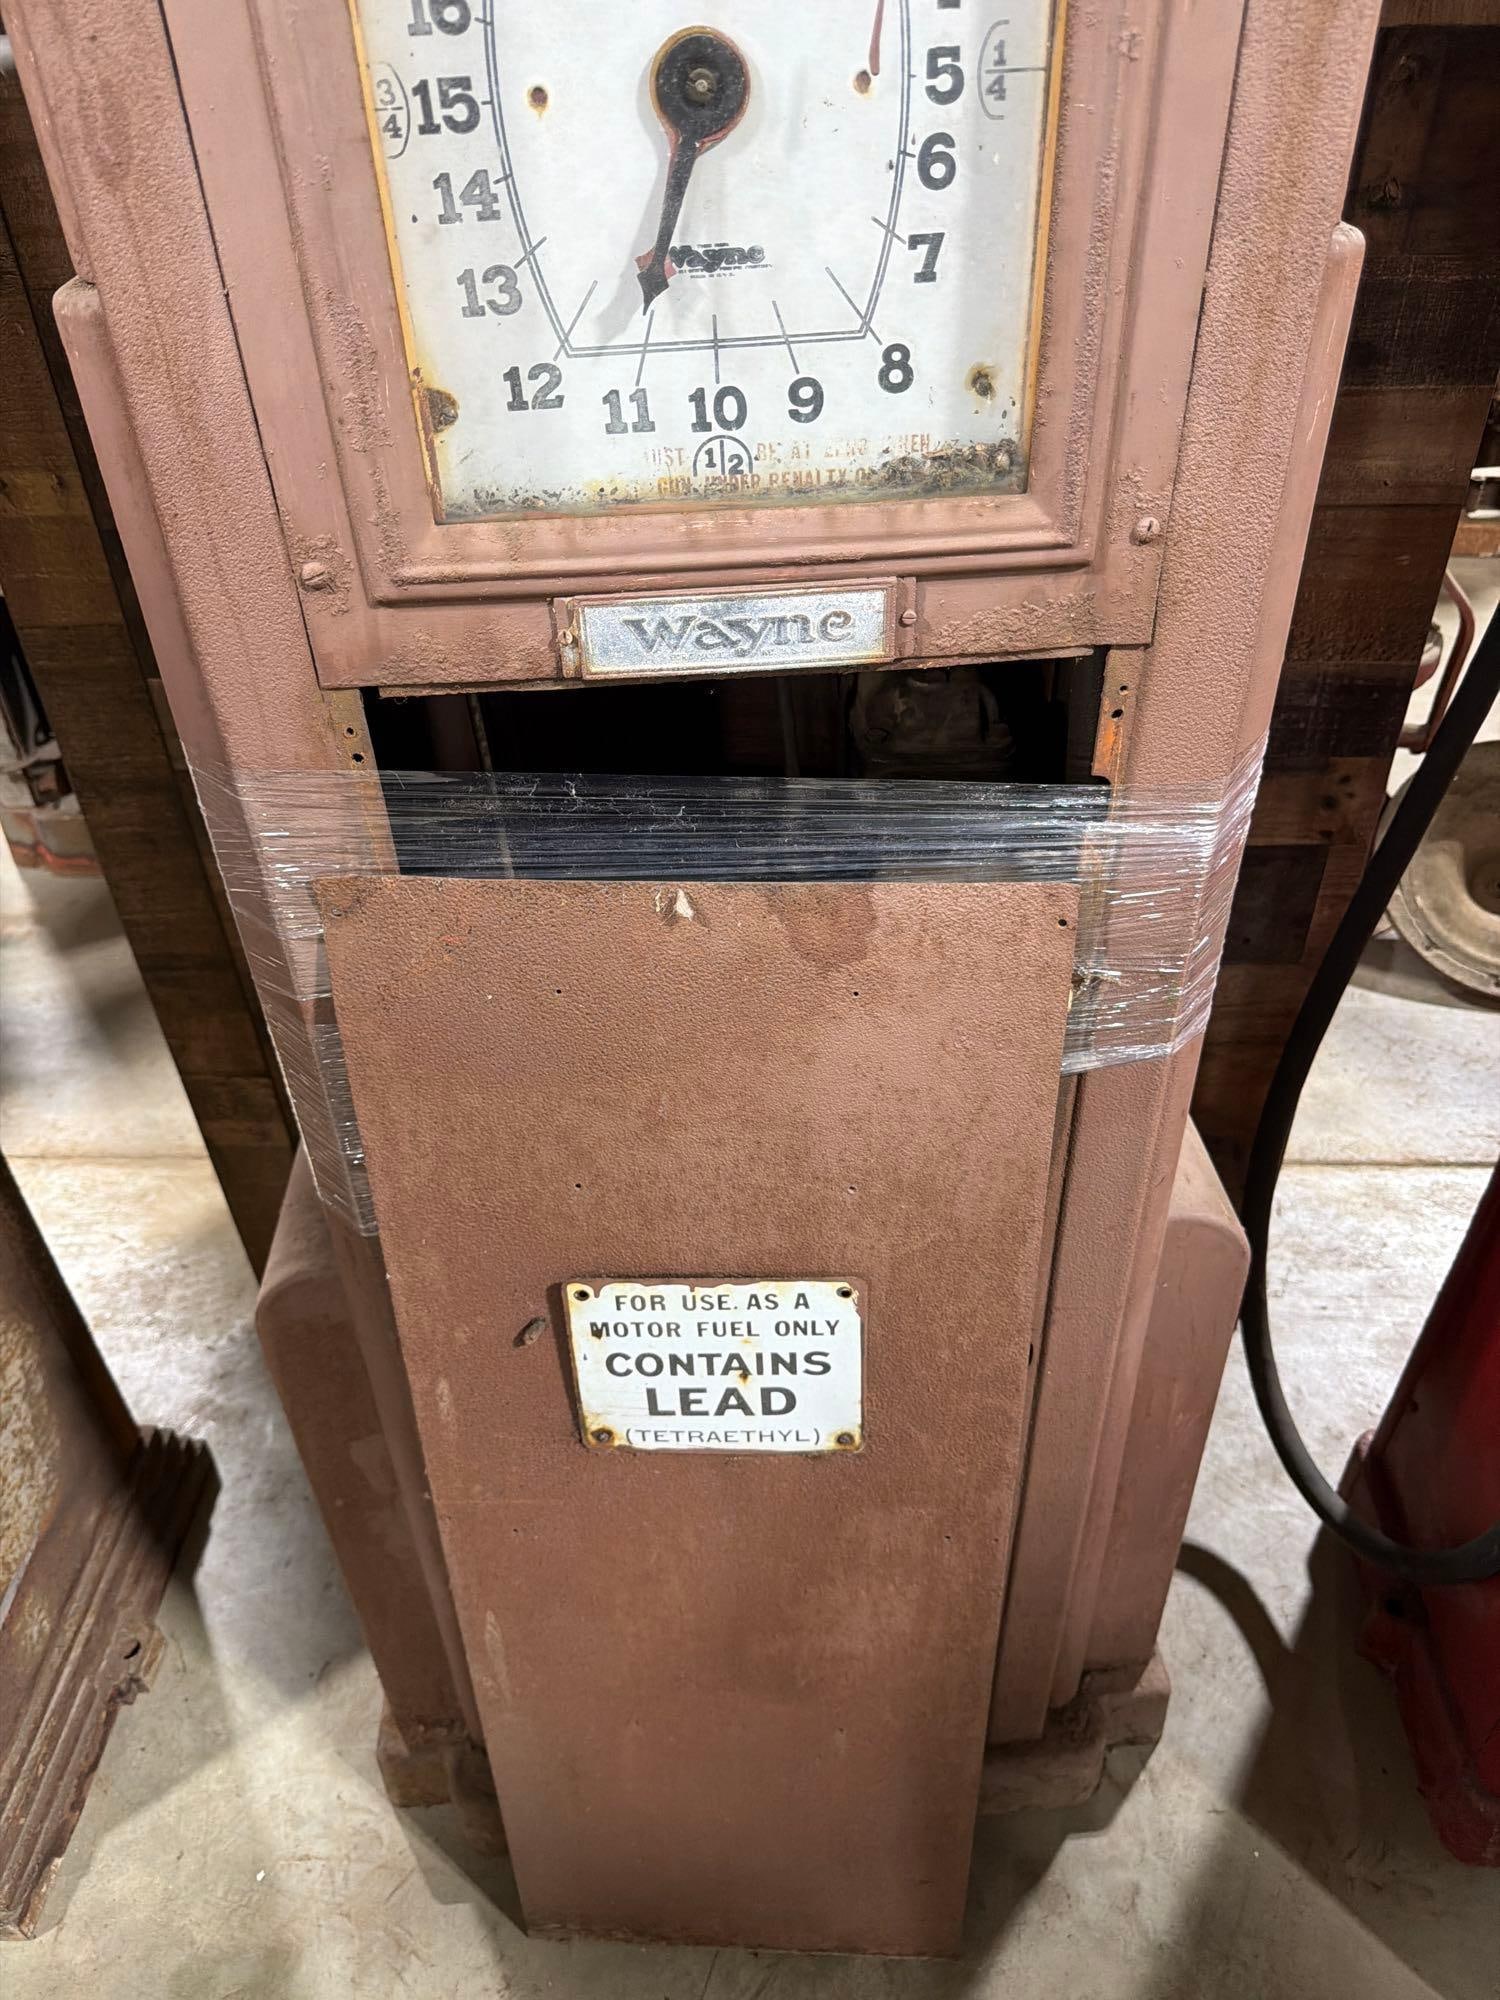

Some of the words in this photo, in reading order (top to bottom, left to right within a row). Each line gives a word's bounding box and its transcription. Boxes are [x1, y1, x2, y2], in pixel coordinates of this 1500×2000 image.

[407, 0, 472, 36] 16
[924, 45, 965, 106] 5
[411, 75, 481, 135] 15
[917, 131, 956, 191] 6
[432, 169, 501, 225] 14
[907, 232, 946, 284] 7
[456, 264, 523, 319] 13
[502, 362, 565, 412] 12
[878, 343, 914, 394] 8
[602, 387, 656, 435] 11
[688, 385, 748, 433] 10
[788, 376, 824, 424] 9
[621, 609, 853, 657] Wayne
[615, 1294, 665, 1311] FOR
[746, 1292, 779, 1310] AS
[794, 1292, 810, 1310] A
[589, 1321, 681, 1339] MOTOR
[697, 1320, 760, 1338] FUEL
[774, 1319, 840, 1337] ONLY
[605, 1351, 832, 1377] CONTAINS
[645, 1386, 798, 1417] LEAD
[625, 1427, 820, 1445] (TETRAETHYL)
